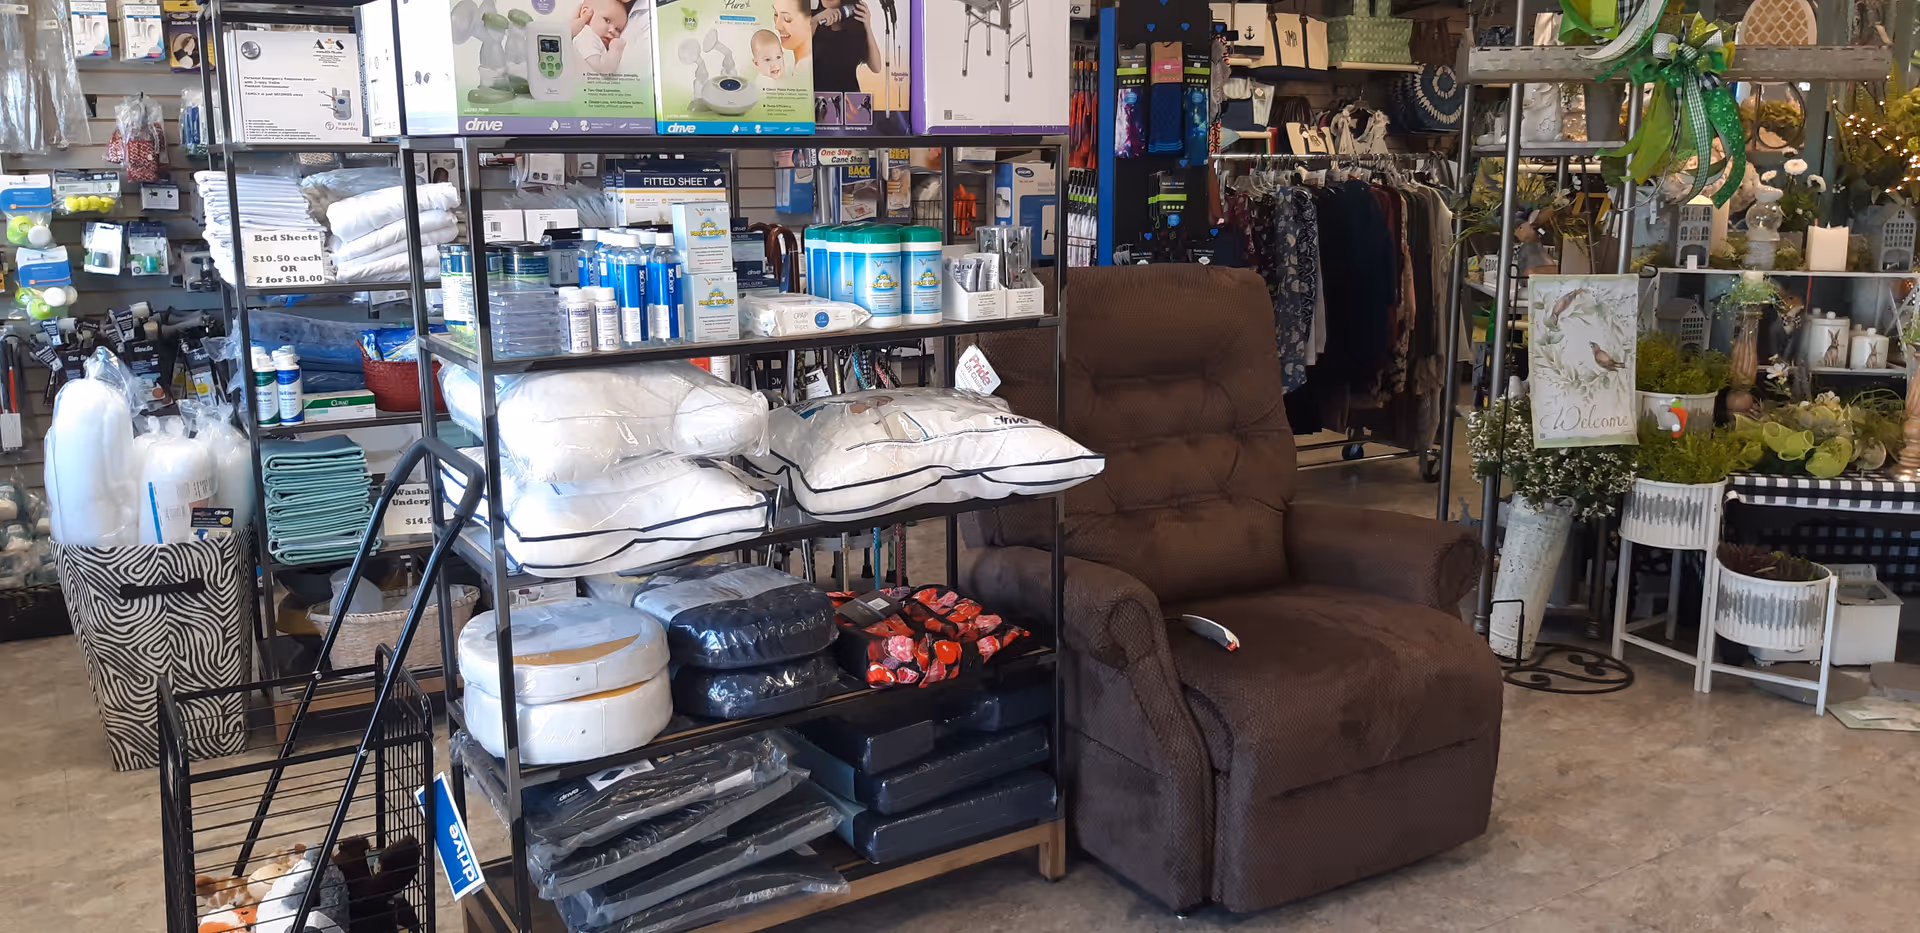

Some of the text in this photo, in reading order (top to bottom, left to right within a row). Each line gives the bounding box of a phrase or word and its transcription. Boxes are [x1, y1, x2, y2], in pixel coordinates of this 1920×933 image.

[724, 0, 745, 10] Pure
[465, 117, 504, 132] drive
[667, 121, 697, 135] drive
[837, 148, 853, 157] Stop
[849, 155, 864, 164] Shop
[848, 166, 871, 176] BACK
[643, 177, 709, 187] FITTED SHEET
[254, 233, 319, 242] Bed Sheets
[252, 254, 322, 263] $10.50 each
[280, 265, 297, 273] OR
[256, 274, 323, 284] 2 for $18.00
[667, 268, 675, 294] SoClean
[968, 353, 992, 387] Pride
[993, 415, 1030, 426] drive
[1539, 404, 1629, 431] Welcome
[395, 488, 430, 496] Washa
[392, 498, 431, 506] Underp
[558, 787, 580, 803] drive
[448, 823, 476, 883] drive
